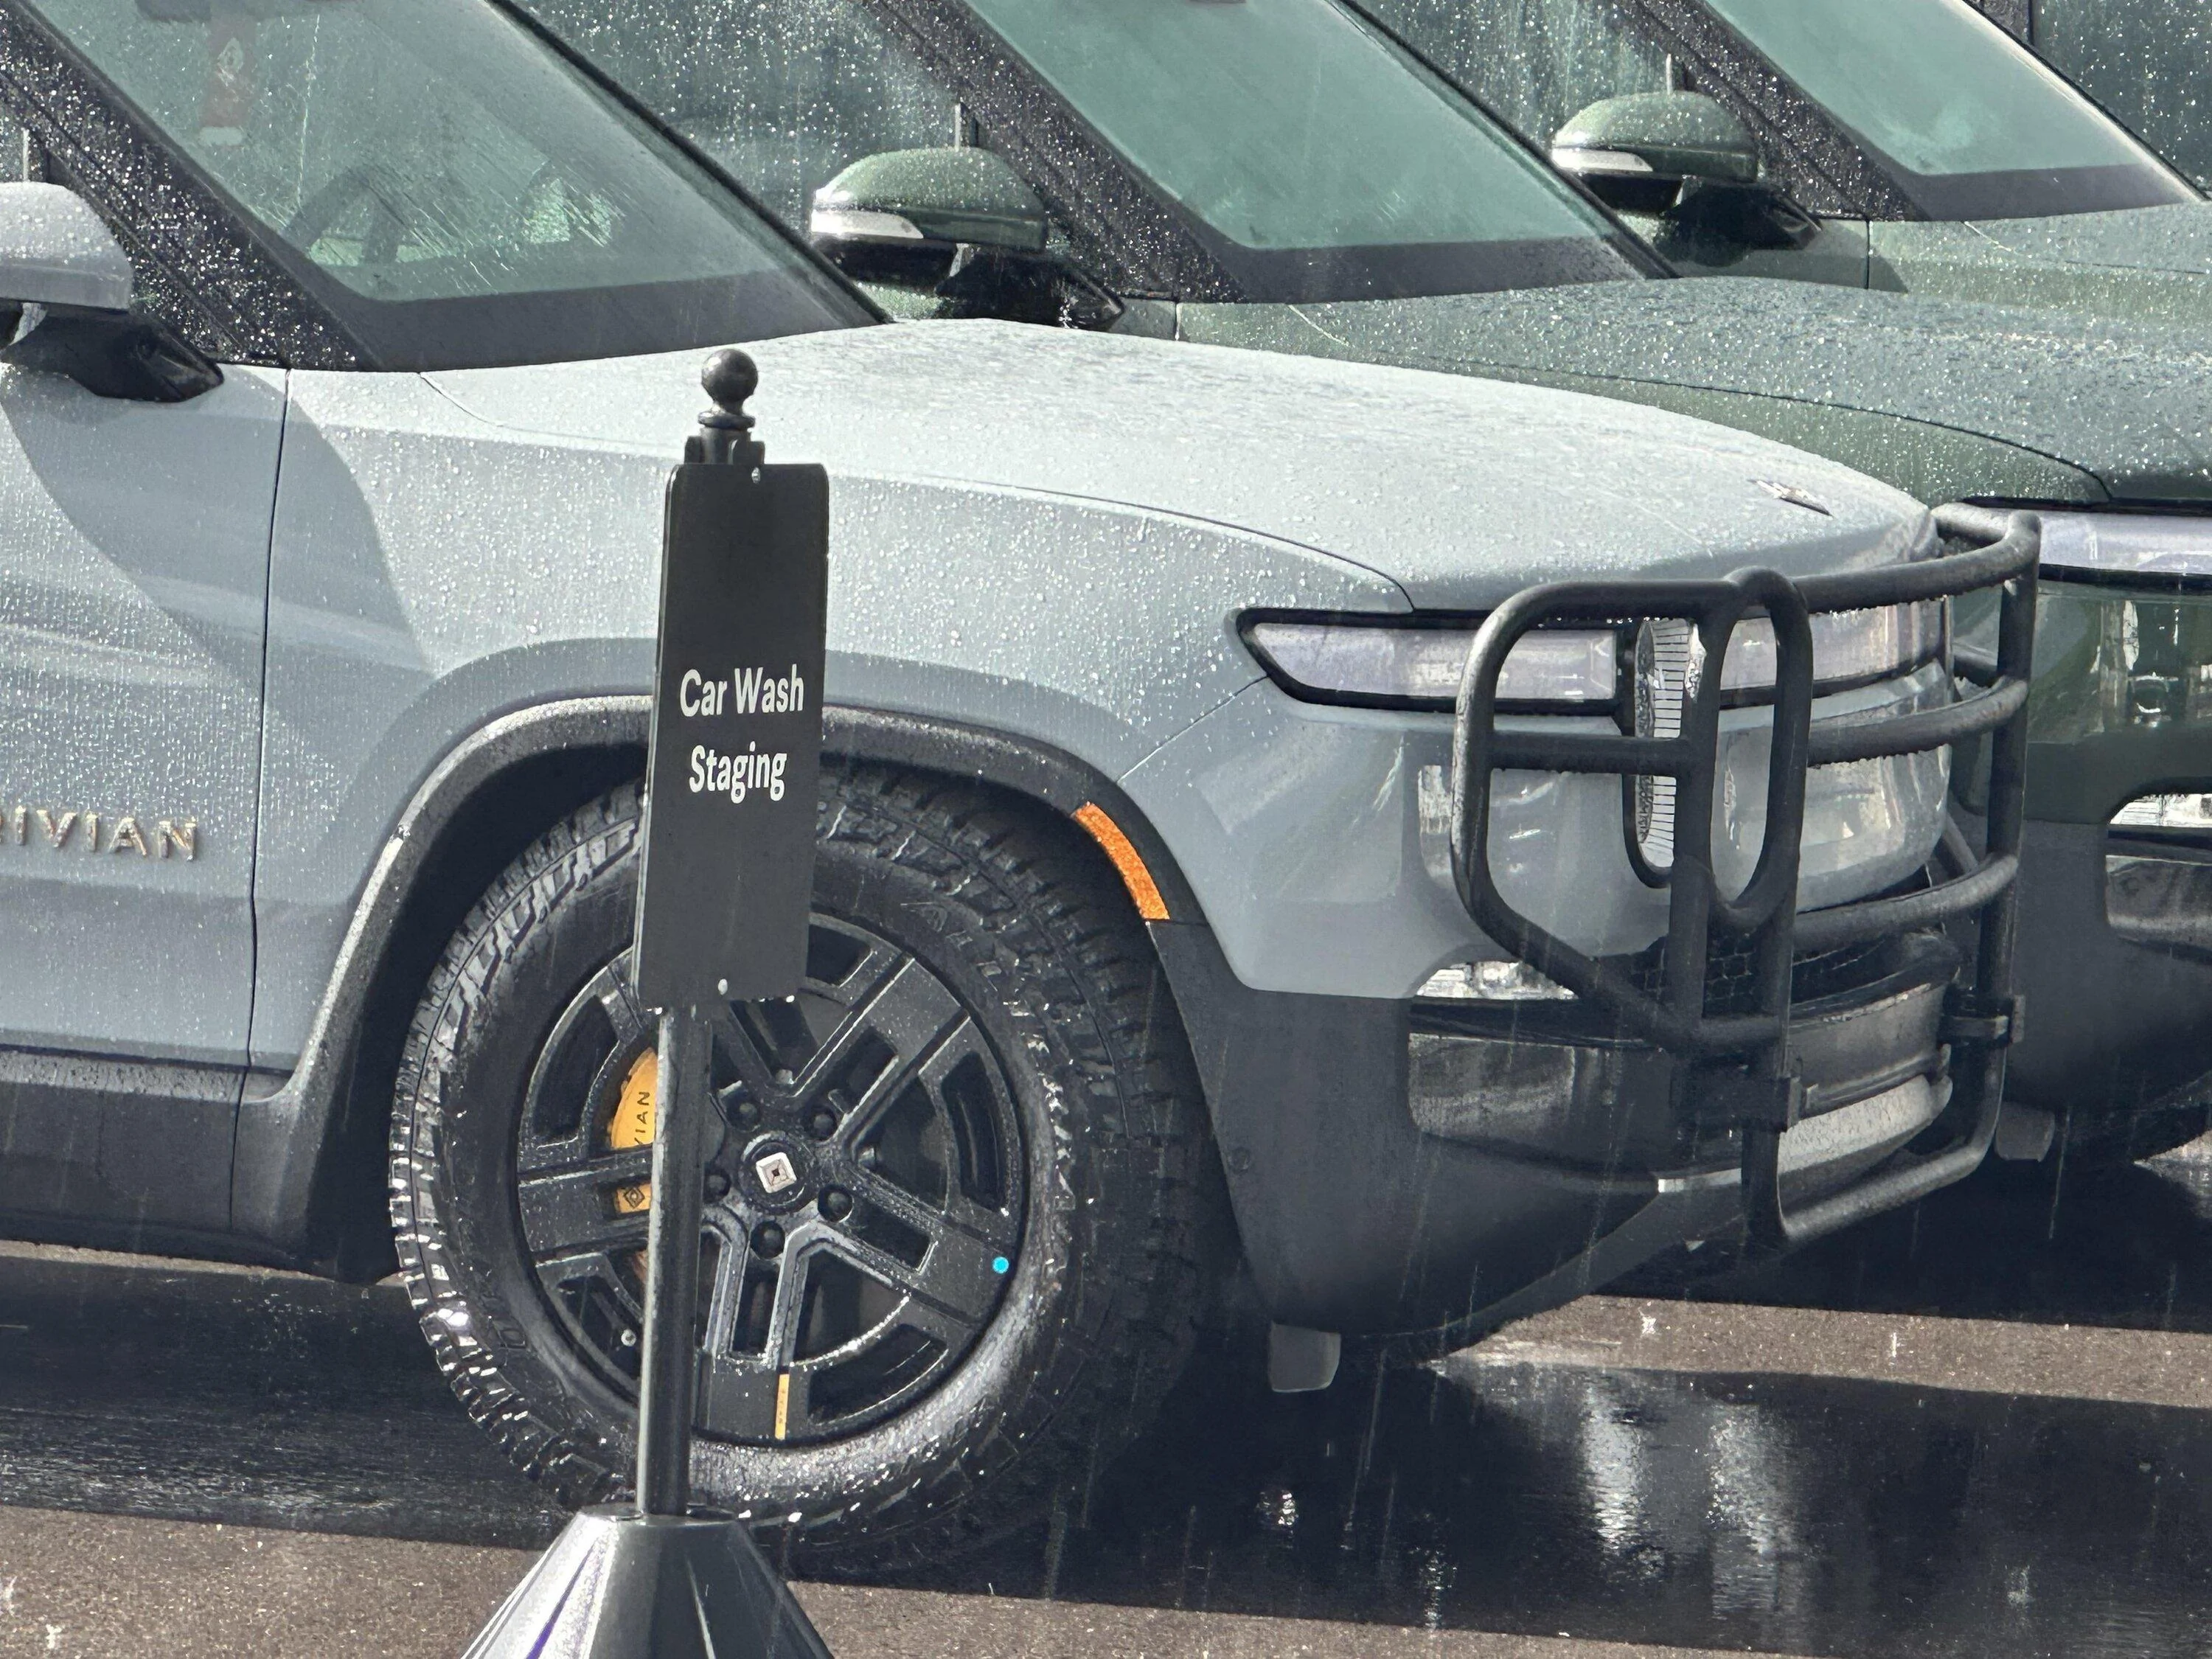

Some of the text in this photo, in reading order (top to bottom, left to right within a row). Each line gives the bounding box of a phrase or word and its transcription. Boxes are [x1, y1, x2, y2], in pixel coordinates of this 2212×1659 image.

[680, 664, 804, 717] Car Wash
[689, 740, 787, 804] Staging
[0, 805, 197, 862] IVIAN
